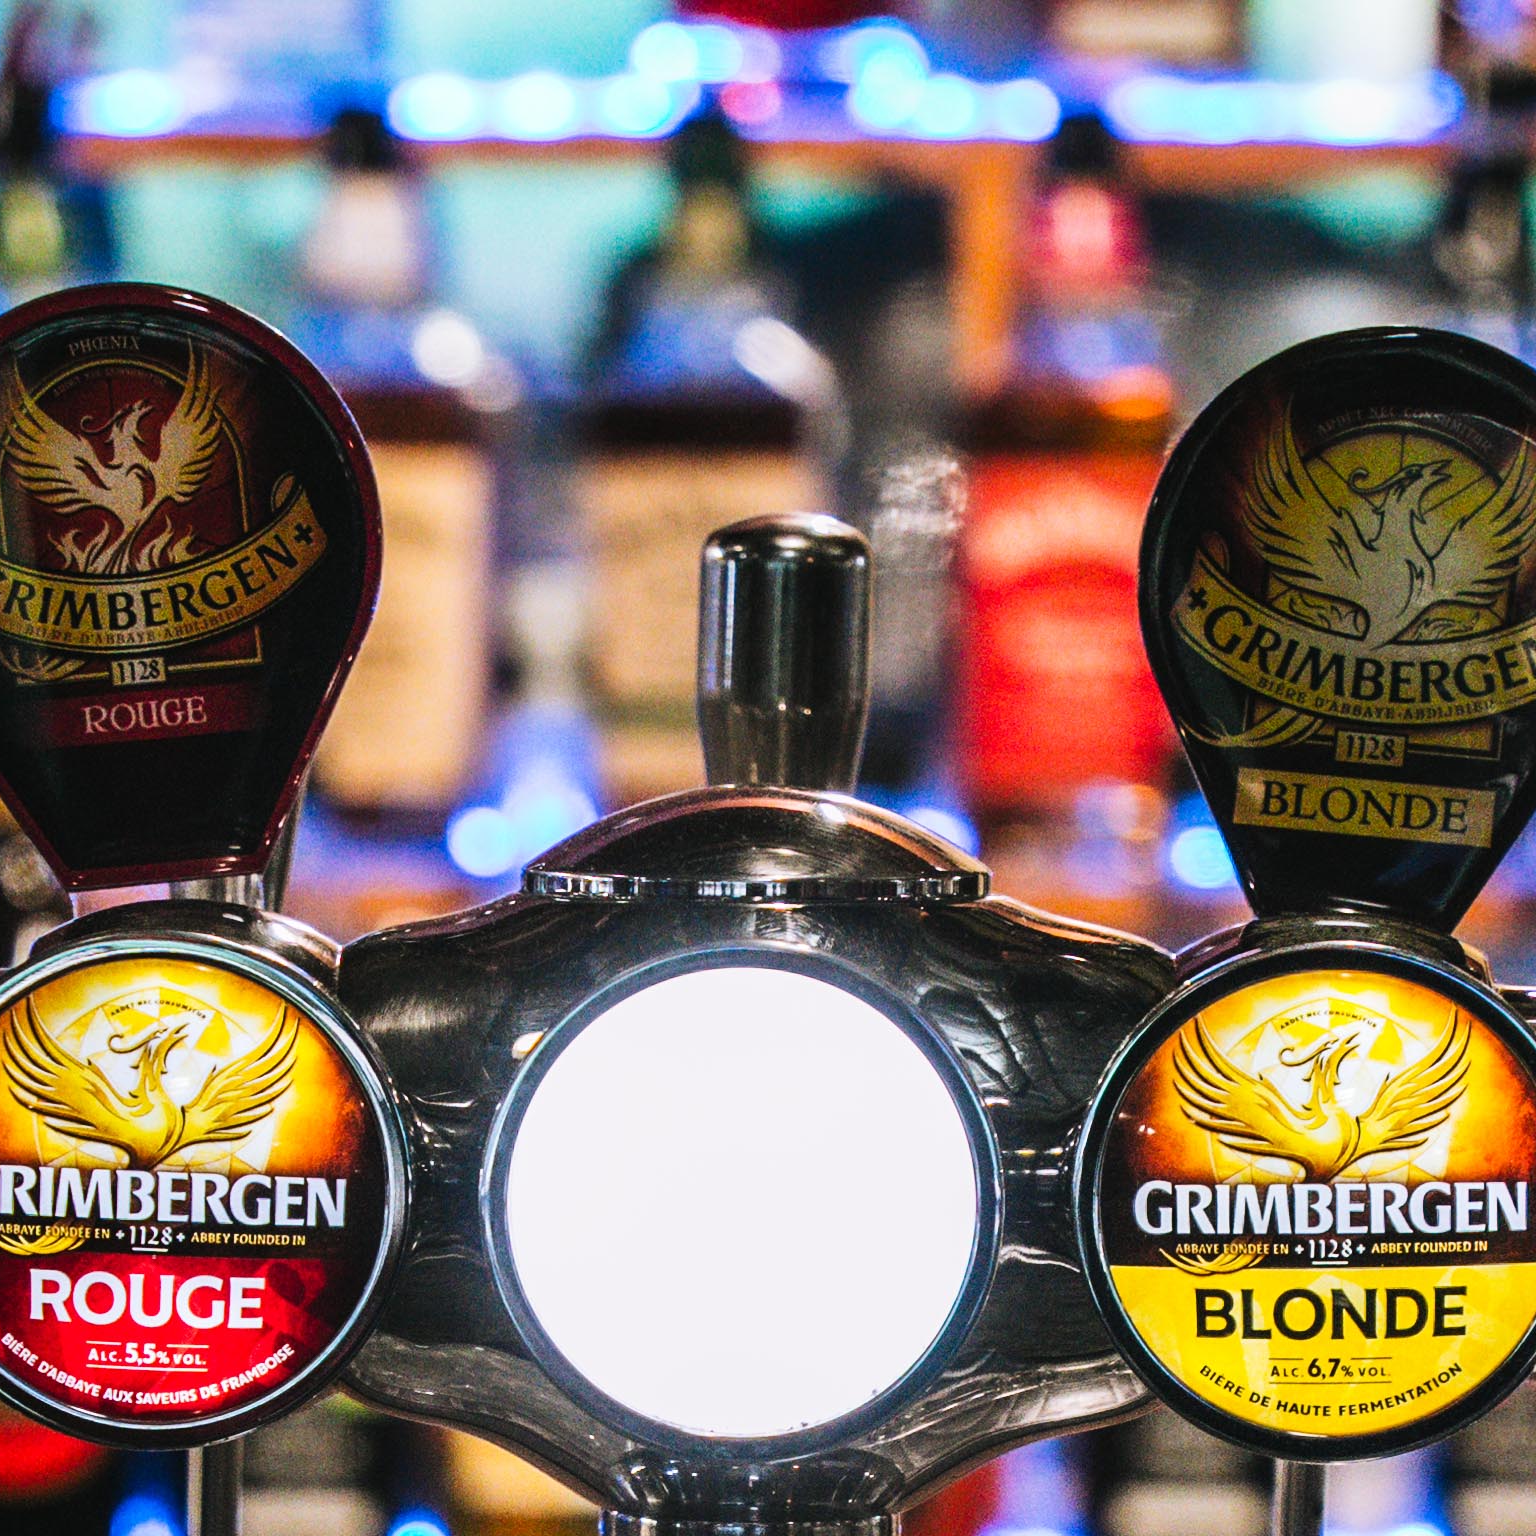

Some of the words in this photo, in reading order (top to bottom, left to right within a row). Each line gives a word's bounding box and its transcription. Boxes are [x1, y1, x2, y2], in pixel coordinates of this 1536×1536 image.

[68, 335, 141, 357] PHŒNIX
[117, 660, 161, 684] 1128
[82, 695, 208, 734] ROUGE
[1346, 733, 1396, 761] 1128
[1259, 780, 1468, 834] BLONDE
[1133, 1179, 1529, 1236] GRIMBERGEN
[45, 1223, 92, 1239] FONDÉE
[94, 1227, 110, 1239] EN
[128, 1225, 173, 1246] 1128
[190, 1231, 230, 1244] ABBEY
[233, 1232, 290, 1246] FOUNDED
[291, 1234, 307, 1246] IN
[1175, 1243, 1220, 1255] ABBAYE
[1223, 1241, 1270, 1255] FONDÉE
[1273, 1243, 1289, 1255] EN
[1308, 1238, 1354, 1260] 1128
[1371, 1242, 1411, 1255] ABBEY
[1414, 1240, 1473, 1254] FOUNDED
[1474, 1240, 1488, 1252] IN
[28, 1267, 267, 1330] ROUGE
[1194, 1286, 1468, 1341] BLONDE
[0, 1332, 38, 1367] BIÈRE
[38, 1360, 101, 1398] D'ABBAYE
[103, 1388, 134, 1405] AUX
[135, 1387, 197, 1406] SAVEURS
[199, 1383, 221, 1398] DE
[221, 1342, 296, 1393] FRAMBOISE
[124, 1342, 170, 1367] 5,5%
[172, 1353, 208, 1366] VOL.
[1307, 1357, 1354, 1380] 6,7%
[1357, 1365, 1391, 1378] VOL.
[1199, 1364, 1246, 1398] BIÈRE
[1248, 1391, 1272, 1408] DE
[1276, 1399, 1332, 1417] HAUTE
[1338, 1361, 1463, 1417] FERMENTATION
